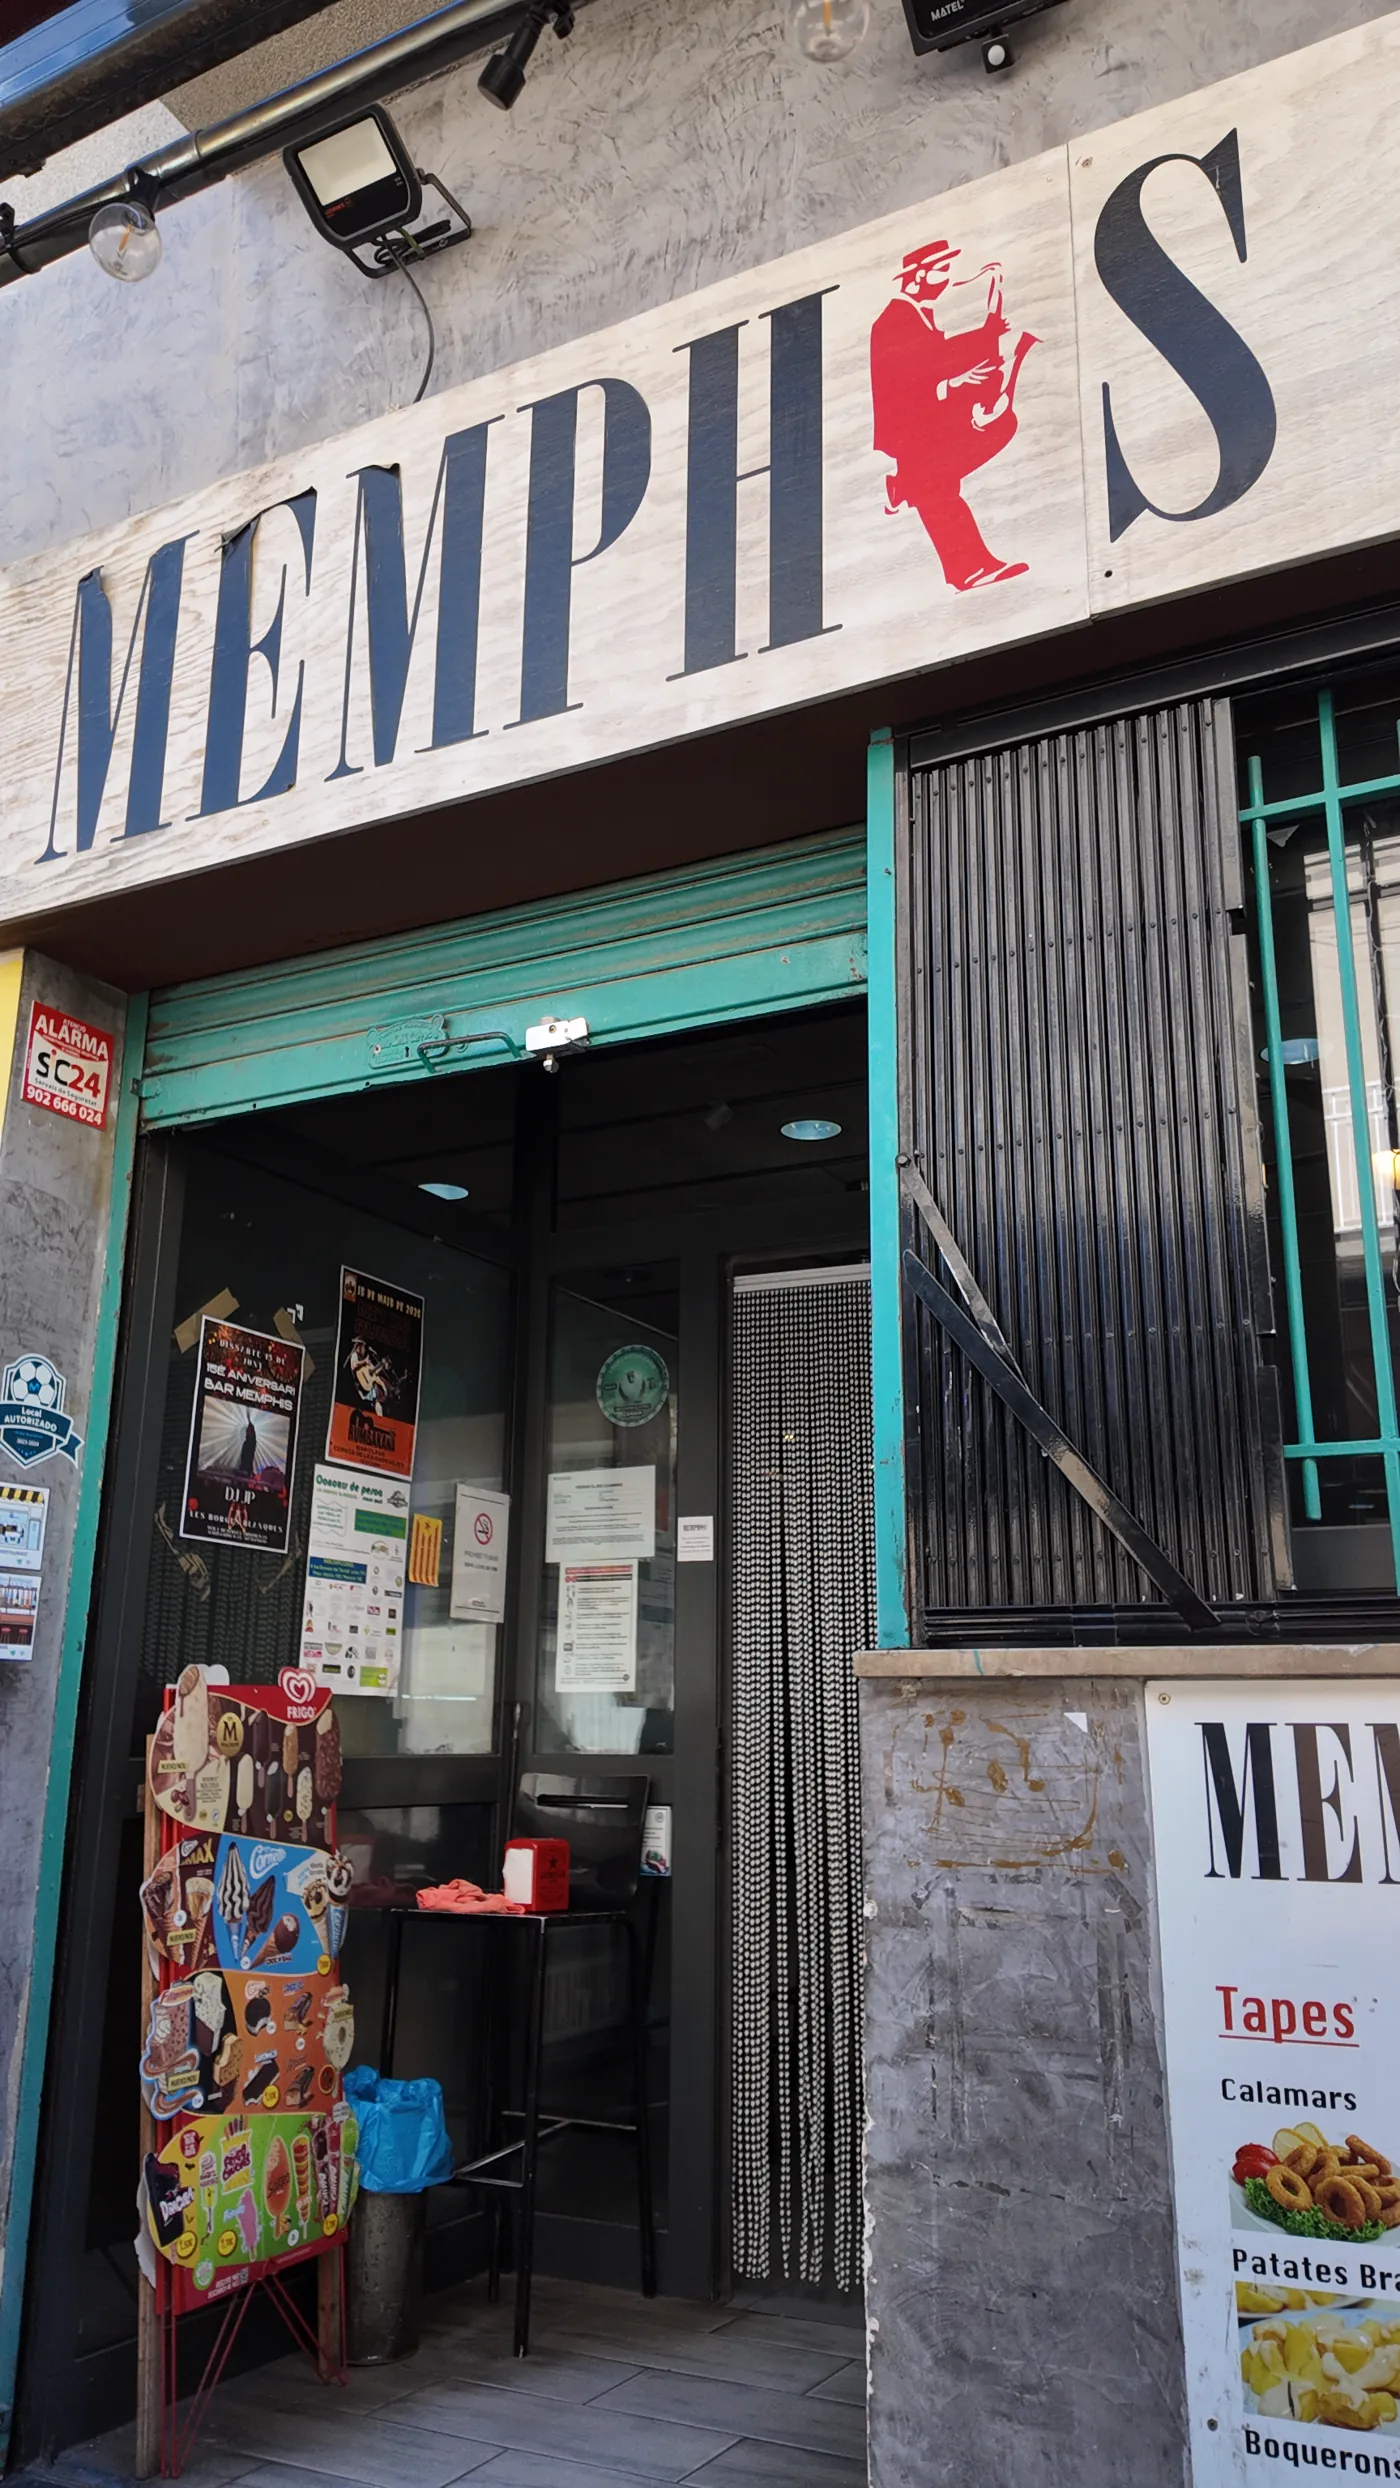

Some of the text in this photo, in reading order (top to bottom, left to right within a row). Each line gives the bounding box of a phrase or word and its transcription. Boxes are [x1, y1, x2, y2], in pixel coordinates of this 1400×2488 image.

[930, 2, 964, 22] MATEL
[35, 128, 1277, 864] MEMPHS
[35, 1014, 108, 1060] ALARMA
[27, 1086, 102, 1125] 902 666 024
[204, 1377, 293, 1411] BAR MEMPHIS
[227, 1368, 295, 1395] ANIVERSARI
[4, 1415, 57, 1432] AUTORIZADO
[21, 1407, 42, 1418] Local
[350, 1482, 359, 1491] de
[287, 1706, 315, 1719] FRIGO
[1215, 1985, 1355, 2043] Tapes
[1221, 2078, 1357, 2111] Calamars
[1232, 2248, 1348, 2285] Patates
